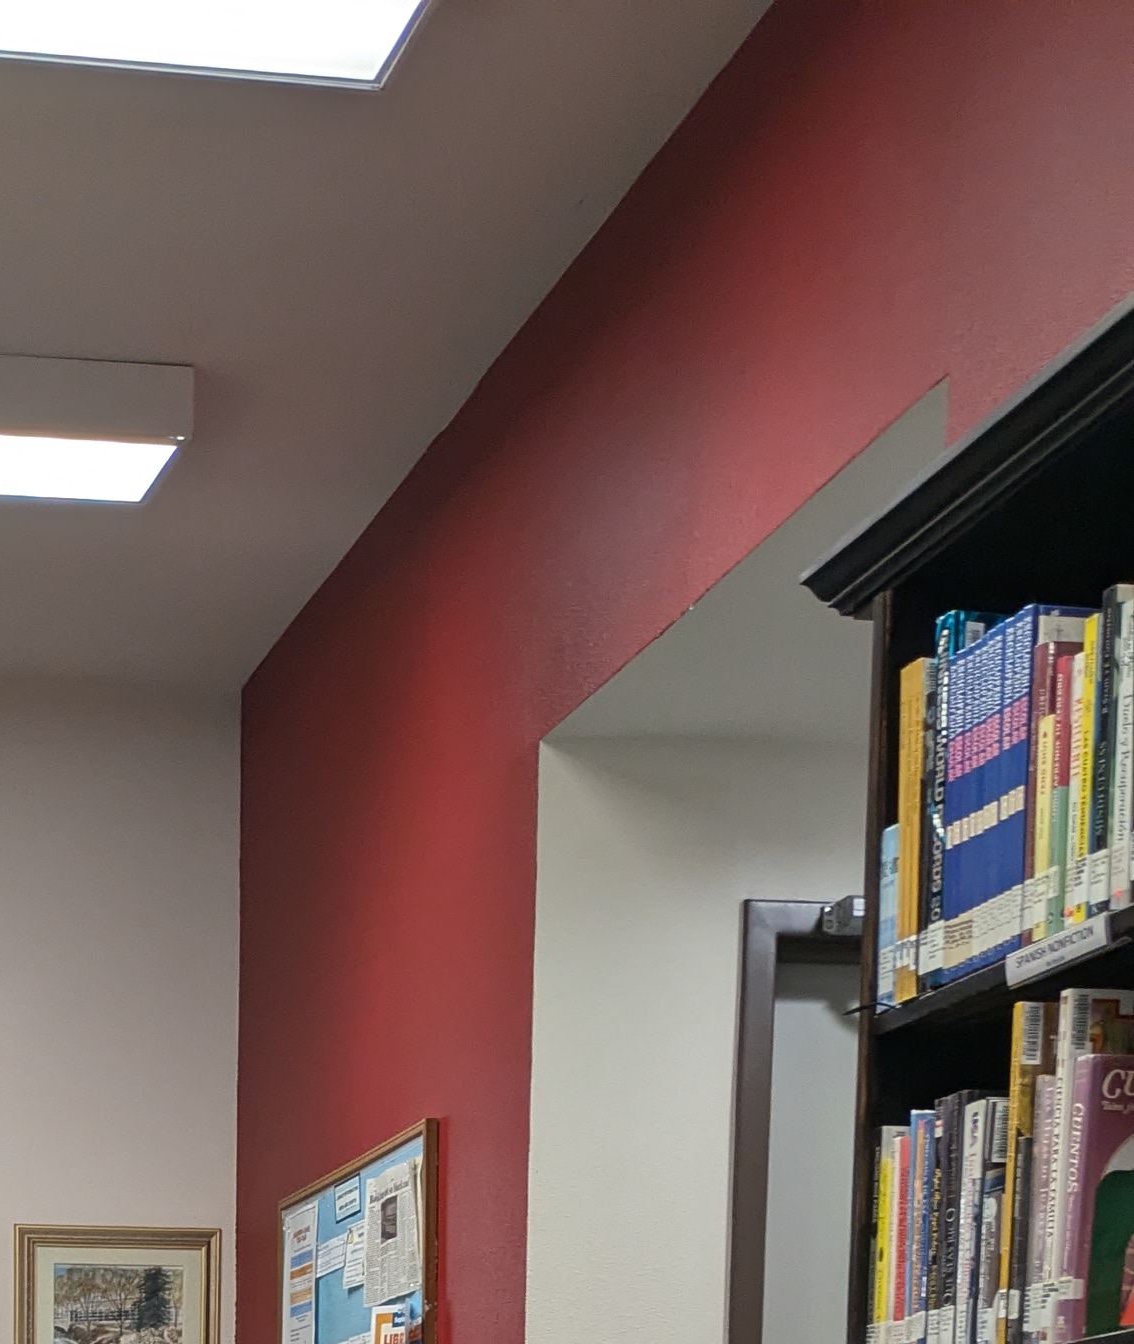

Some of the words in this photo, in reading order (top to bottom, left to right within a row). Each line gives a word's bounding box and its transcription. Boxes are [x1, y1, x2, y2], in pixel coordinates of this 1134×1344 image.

[1122, 693, 1134, 736] Duelo
[933, 735, 946, 801] WORLD
[1094, 741, 1107, 836] MINDFULNESS
[1117, 749, 1132, 842] Recuperación
[1015, 948, 1046, 969] SPANISH
[1052, 1077, 1063, 1129] CIENCIA
[1041, 1117, 1052, 1161] HIJAS
[1050, 1133, 1060, 1163] PARA
[1066, 1102, 1086, 1194] CUENTOS
[1046, 1188, 1057, 1238] FAMILIA
